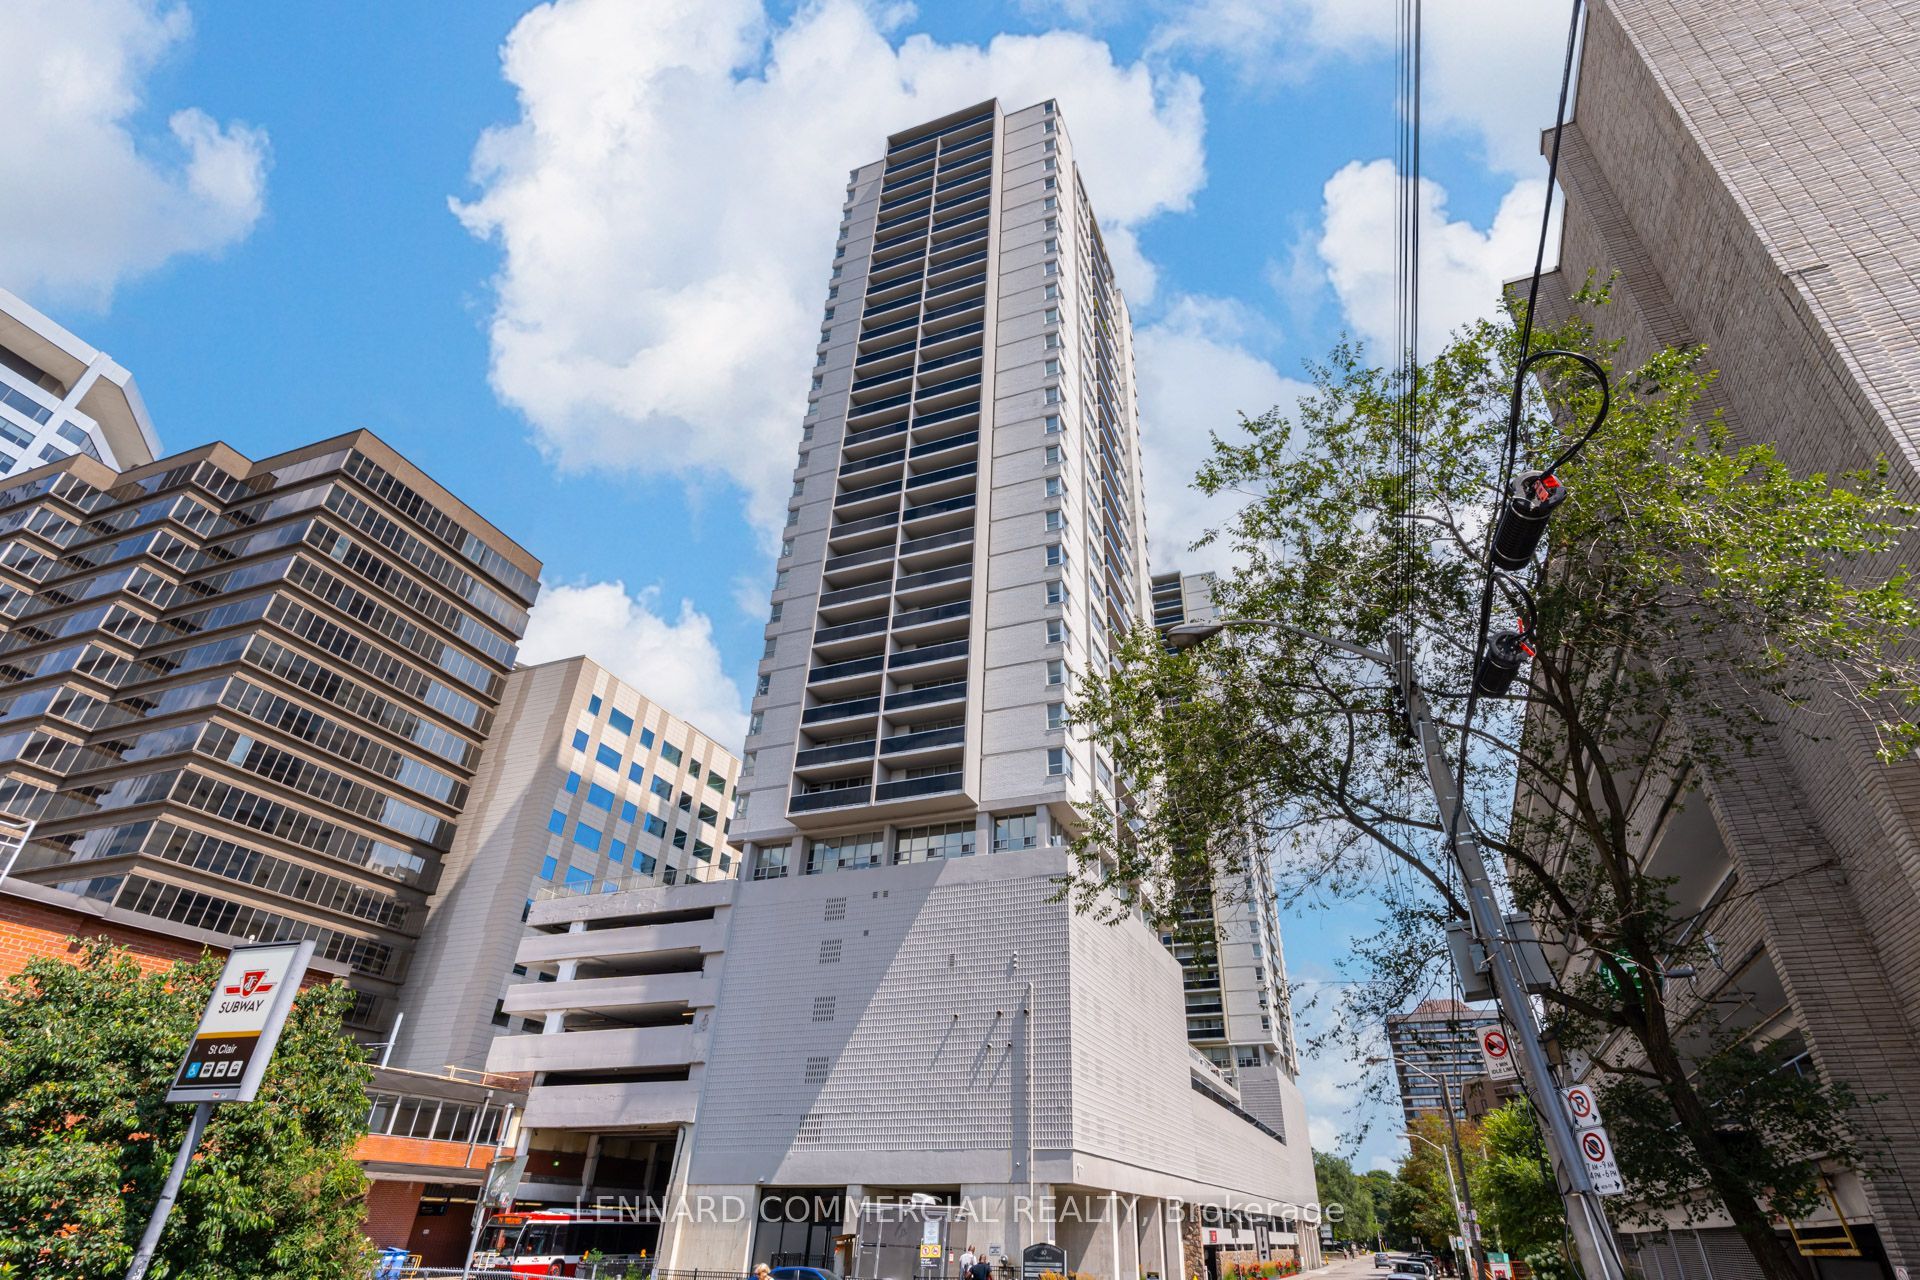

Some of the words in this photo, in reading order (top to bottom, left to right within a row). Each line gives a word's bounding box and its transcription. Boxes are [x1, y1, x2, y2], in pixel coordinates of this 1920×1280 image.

[218, 999, 265, 1014] SUBWAY
[208, 1044, 218, 1055] St
[218, 1043, 238, 1055] Clair
[1586, 1163, 1590, 1171] 7
[1601, 1160, 1606, 1169] 9
[1590, 1171, 1594, 1180] 4
[1605, 1169, 1610, 1178] 6
